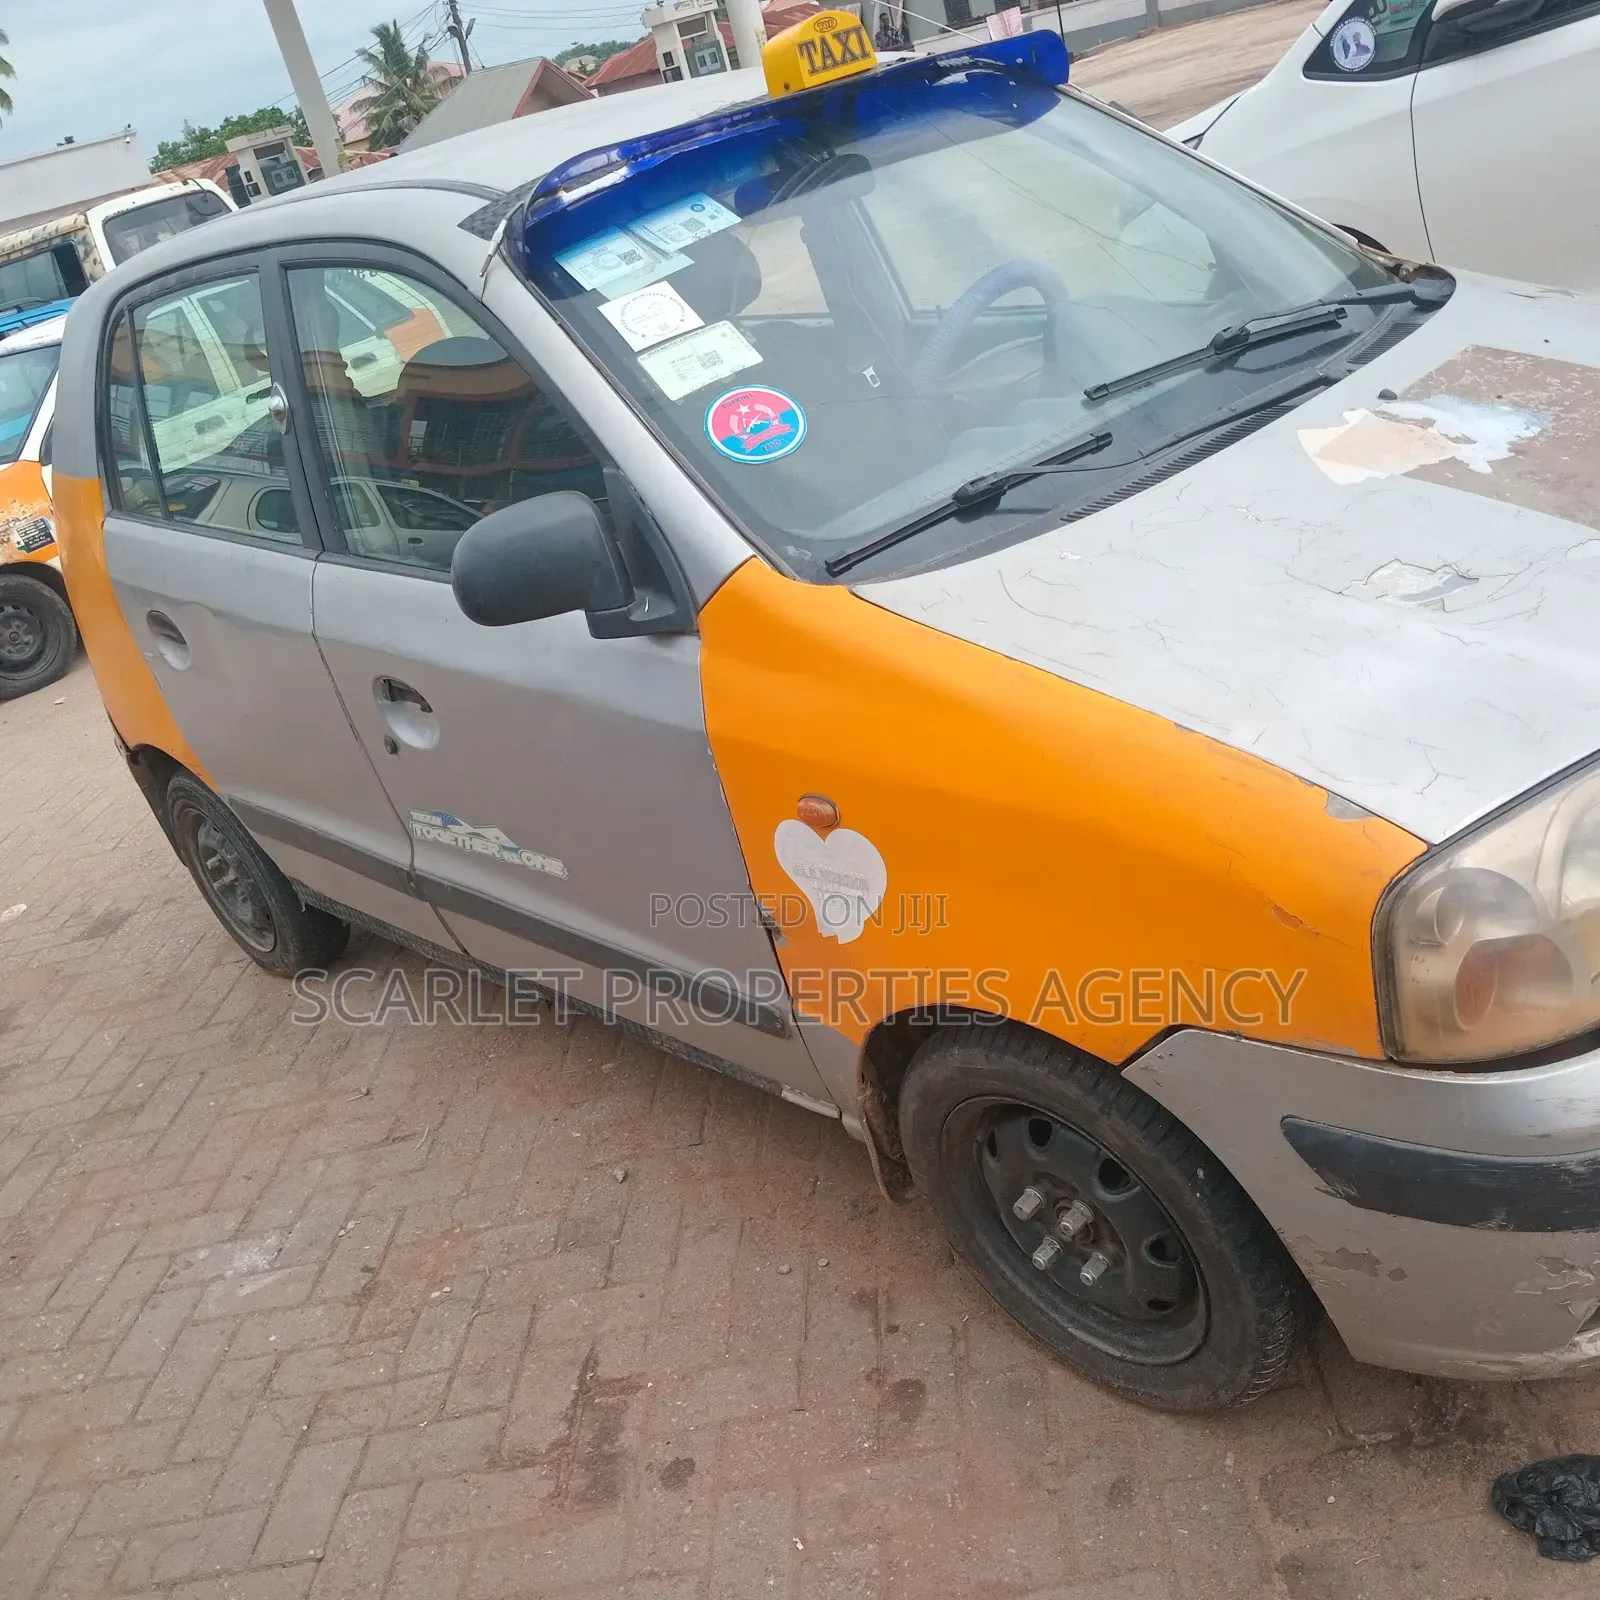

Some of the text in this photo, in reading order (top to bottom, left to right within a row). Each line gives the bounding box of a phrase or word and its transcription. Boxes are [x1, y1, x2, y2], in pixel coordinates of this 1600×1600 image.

[816, 18, 836, 32] TOP
[797, 25, 871, 76] TAXI
[721, 392, 754, 409] BURKINA
[762, 440, 781, 452] FASO
[412, 825, 503, 860] TOGETHER
[520, 851, 565, 877] ONE
